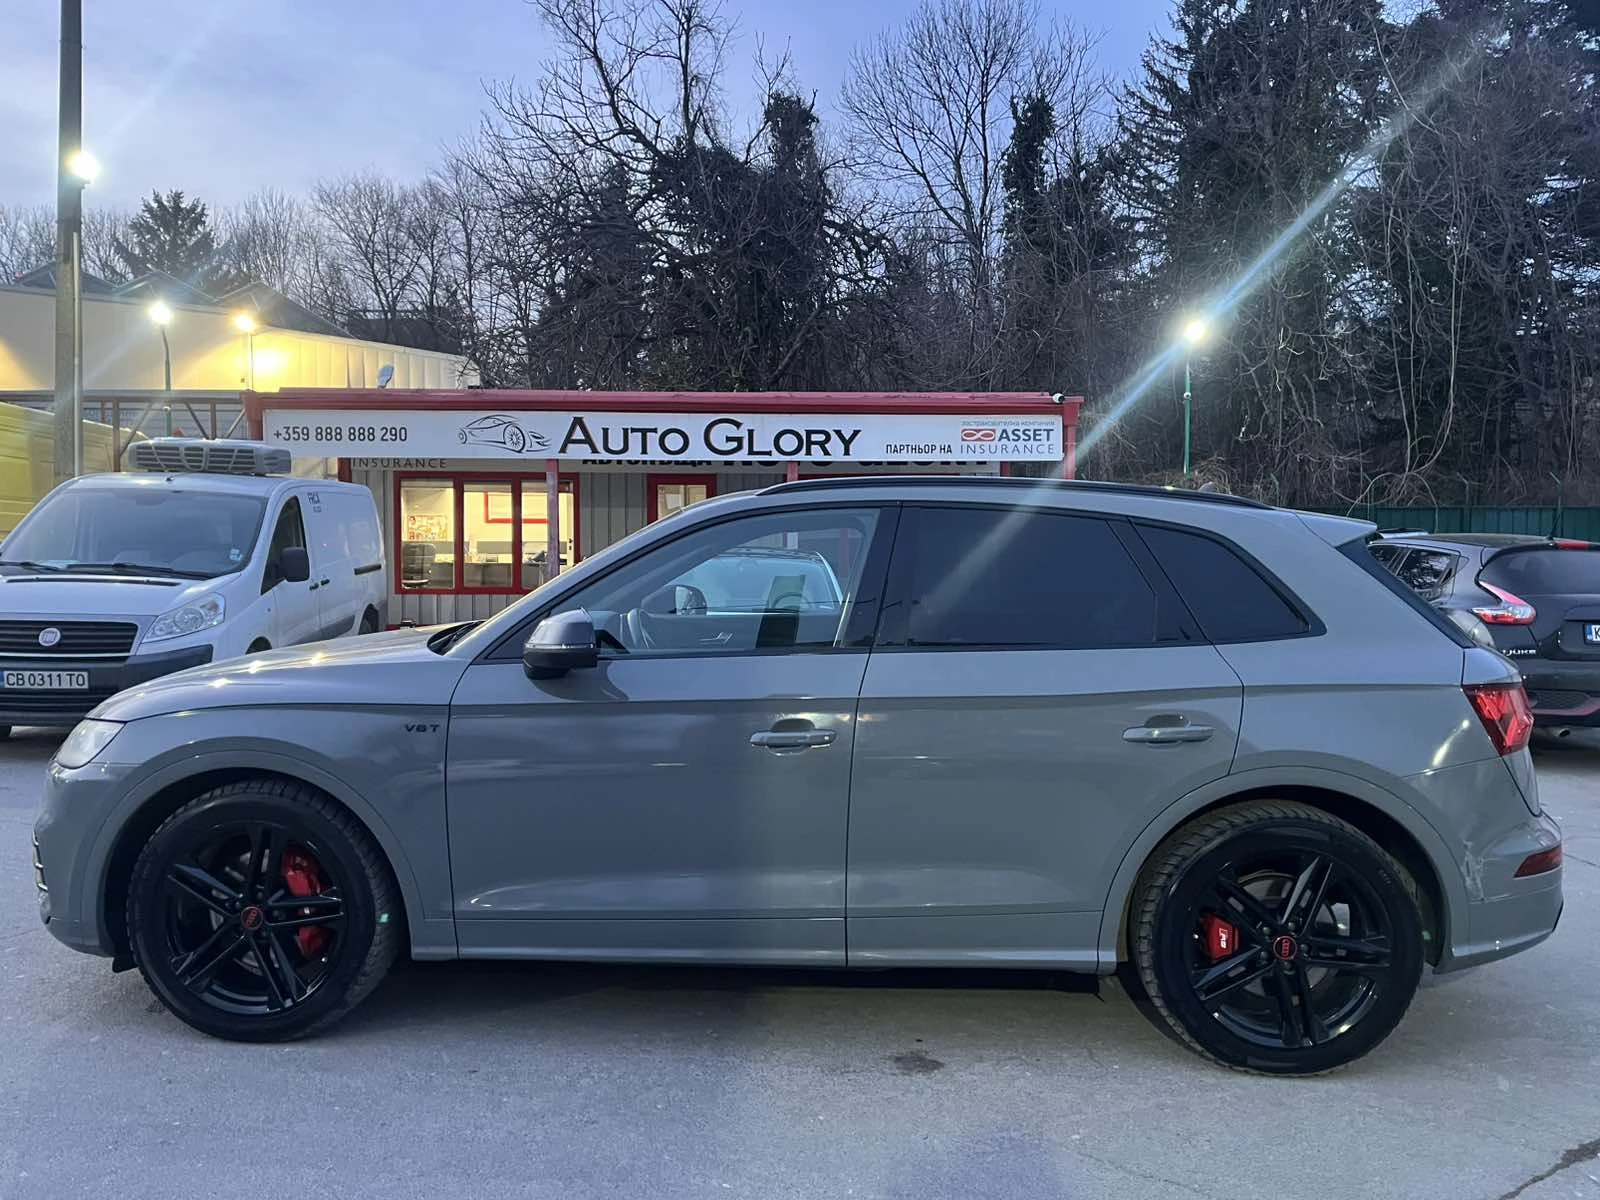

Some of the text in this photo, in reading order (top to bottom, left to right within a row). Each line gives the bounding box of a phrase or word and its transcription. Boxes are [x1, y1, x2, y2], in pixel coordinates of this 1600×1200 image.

[273, 426, 408, 442] +359 888 888 290
[998, 428, 1055, 442] ASSET
[886, 444, 953, 454] ПАРТНЬОР НА
[960, 443, 1055, 455] INSURANCE
[352, 458, 448, 468] INSURANCE
[6, 672, 86, 687] CB 0311 TO
